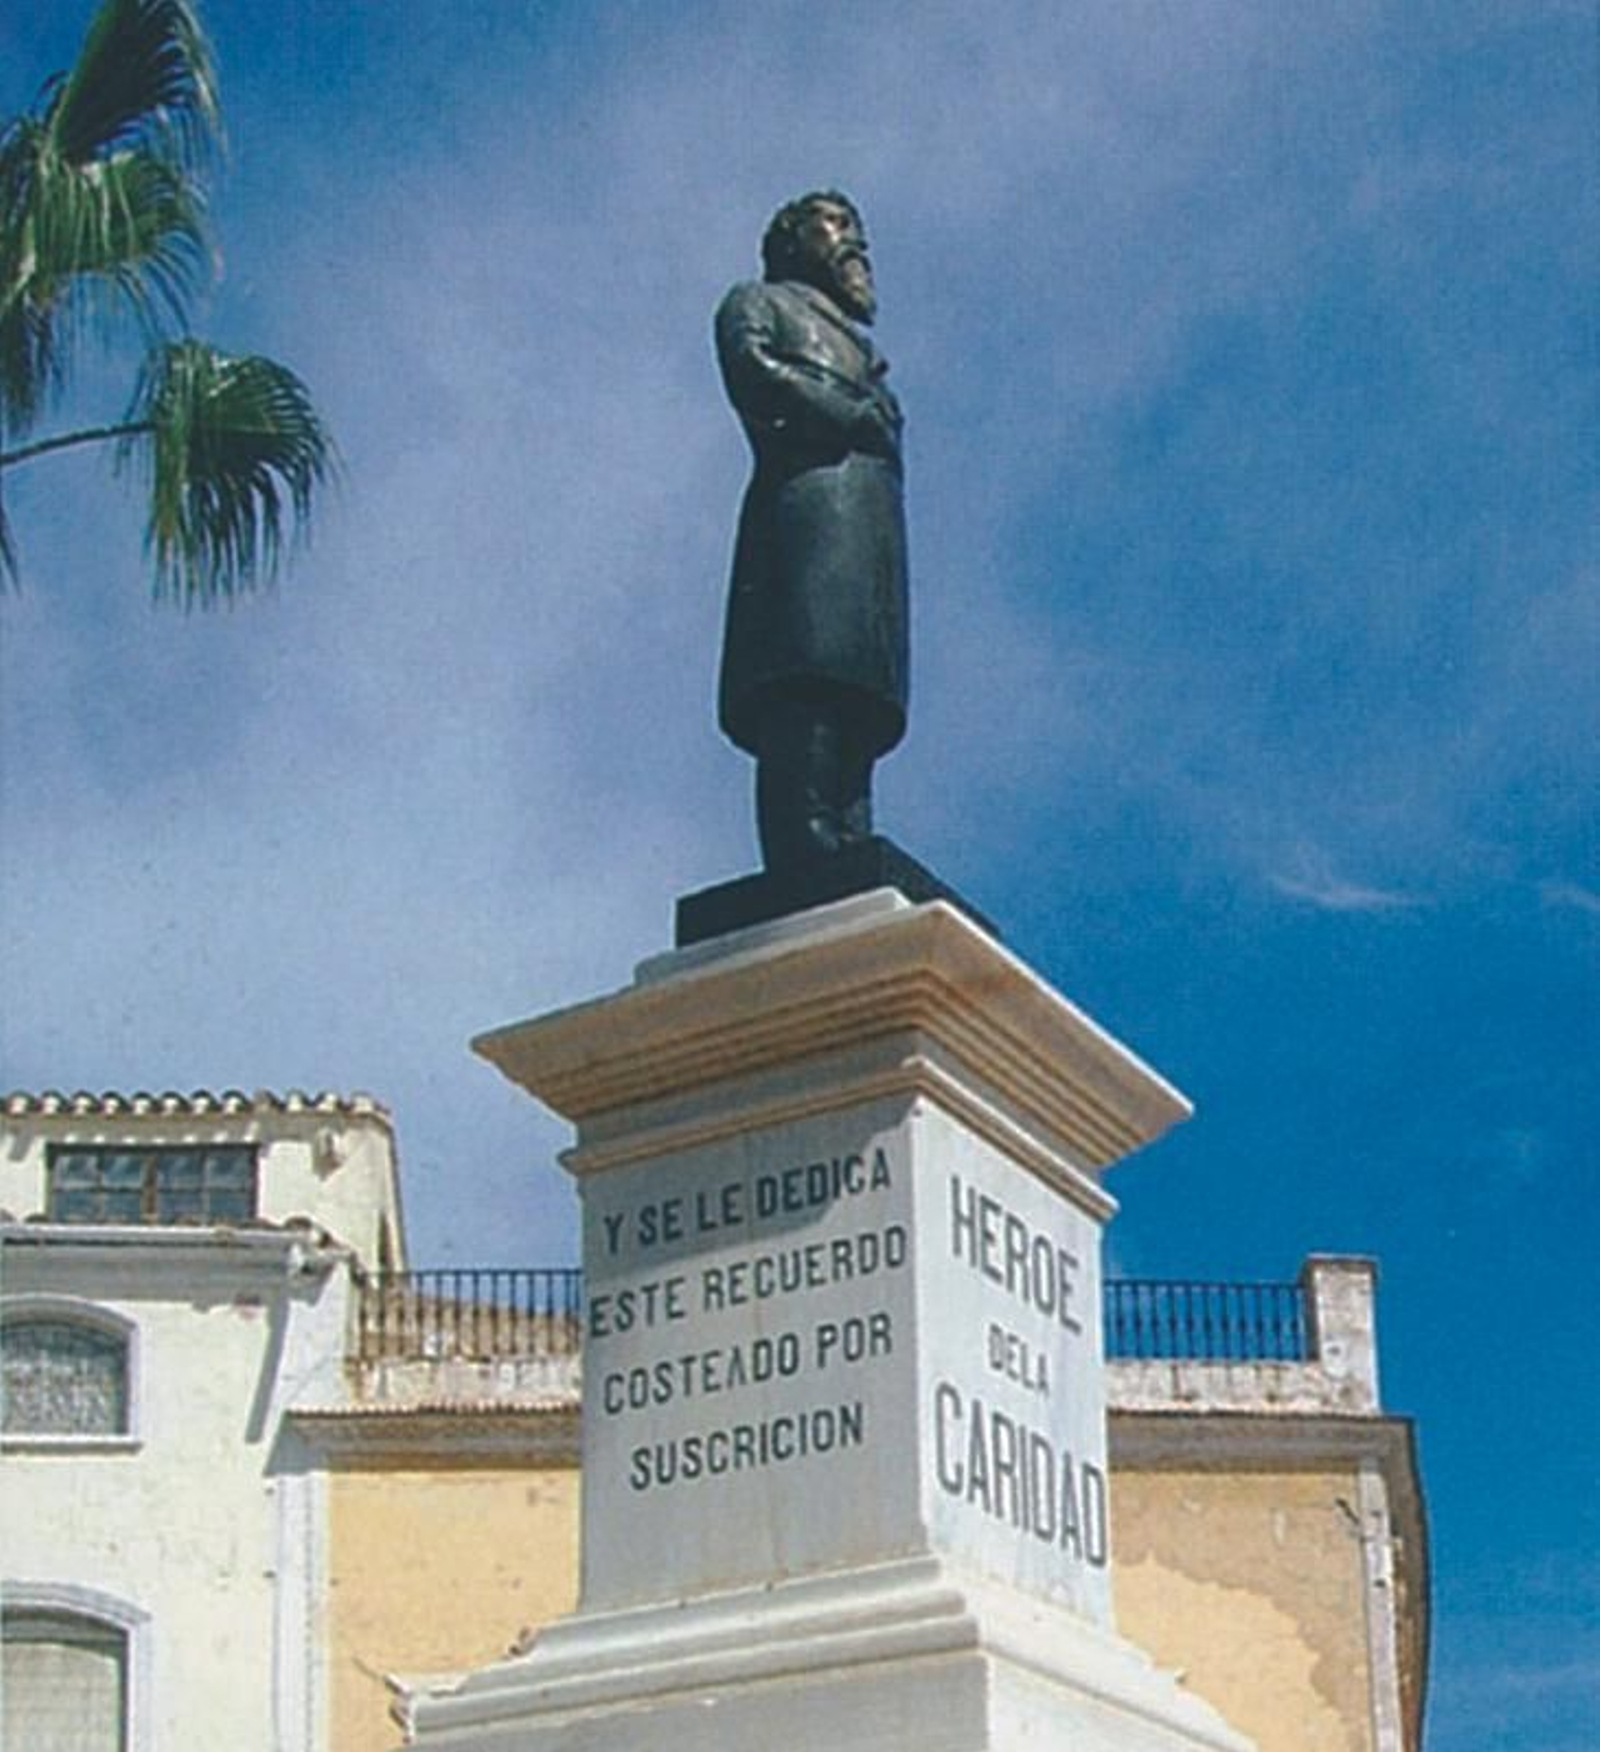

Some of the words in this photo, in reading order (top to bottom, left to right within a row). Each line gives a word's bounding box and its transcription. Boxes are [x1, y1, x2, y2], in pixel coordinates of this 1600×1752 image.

[603, 1212, 623, 1255] Y
[638, 1198, 684, 1248] SE
[698, 1183, 744, 1233] LE
[755, 1147, 892, 1219] DEDICA
[950, 1174, 1083, 1335] HEROE
[590, 1276, 686, 1338] ESTE
[703, 1225, 907, 1312] RECUERDO
[603, 1333, 800, 1415] COSTEADO
[817, 1312, 893, 1370] POR
[629, 1402, 863, 1492] SUSCRICION
[934, 1381, 1107, 1568] CARIDAD
